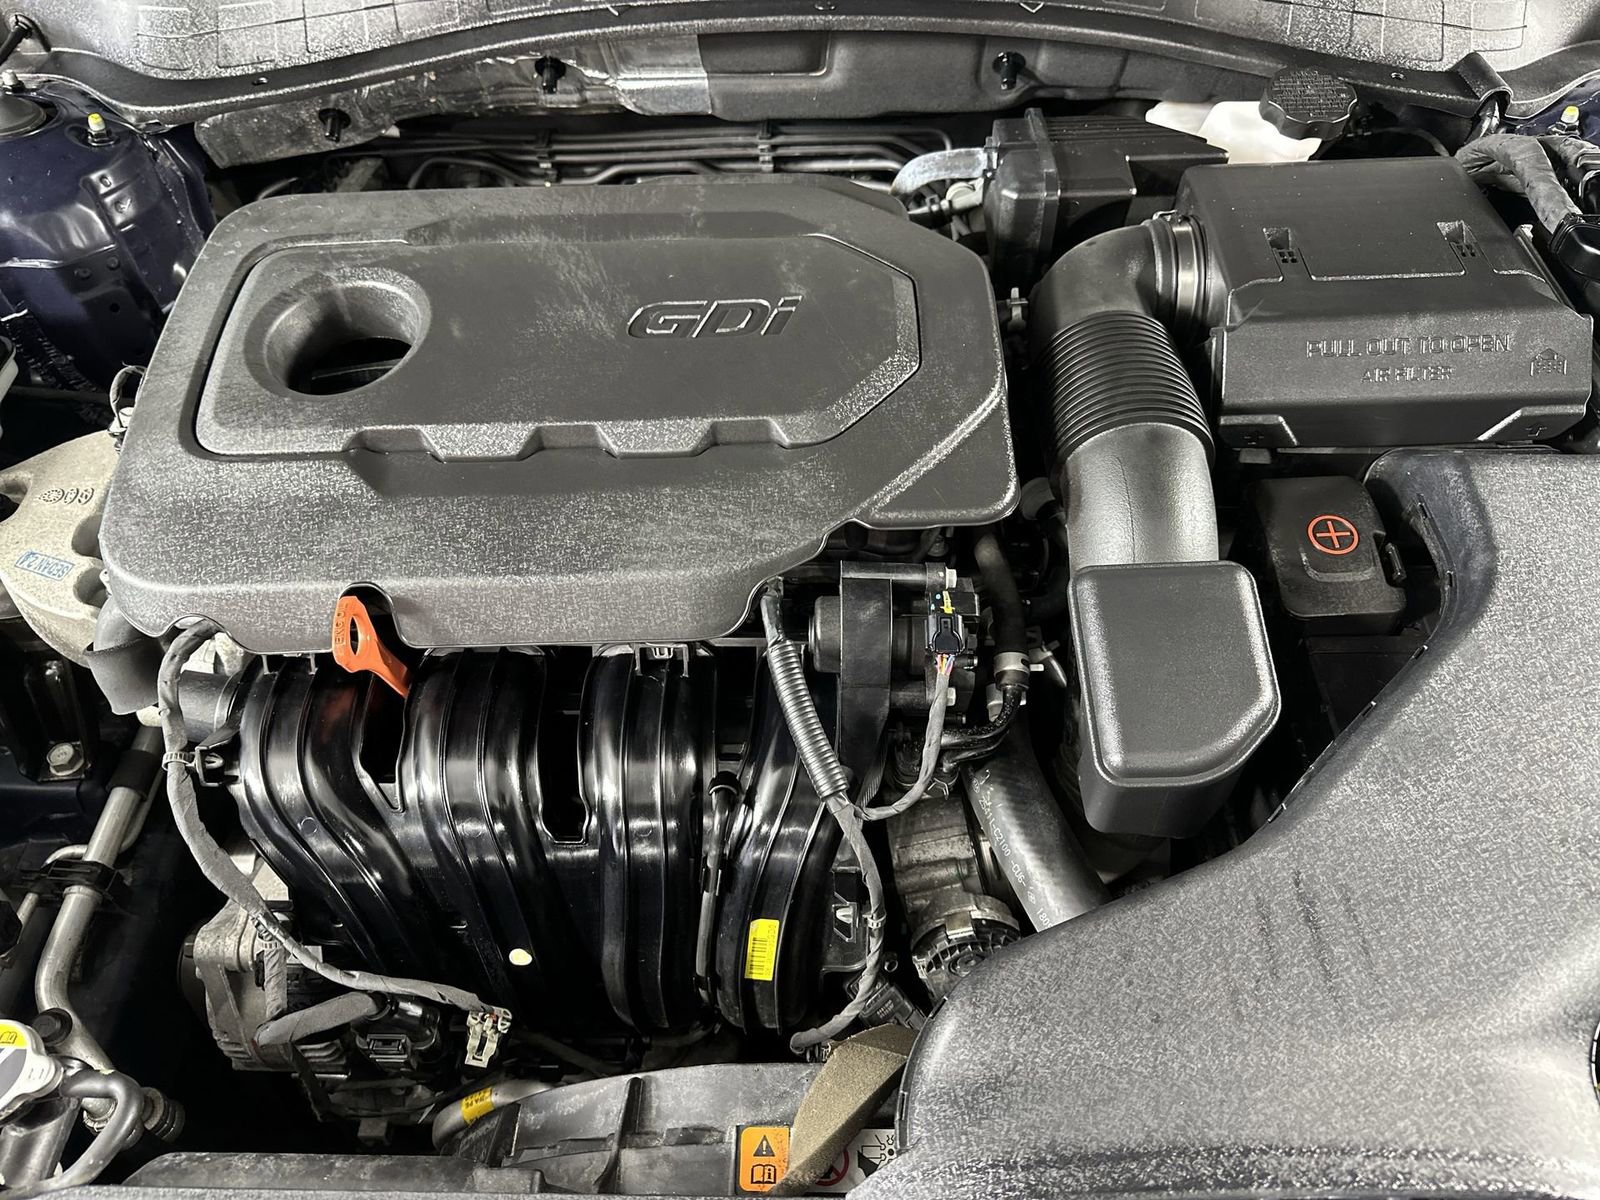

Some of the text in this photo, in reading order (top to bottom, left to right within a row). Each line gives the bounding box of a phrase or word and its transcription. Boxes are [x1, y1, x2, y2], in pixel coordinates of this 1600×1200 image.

[627, 295, 802, 339] GDi
[1306, 334, 1511, 358] PULL OUT TO OPEN
